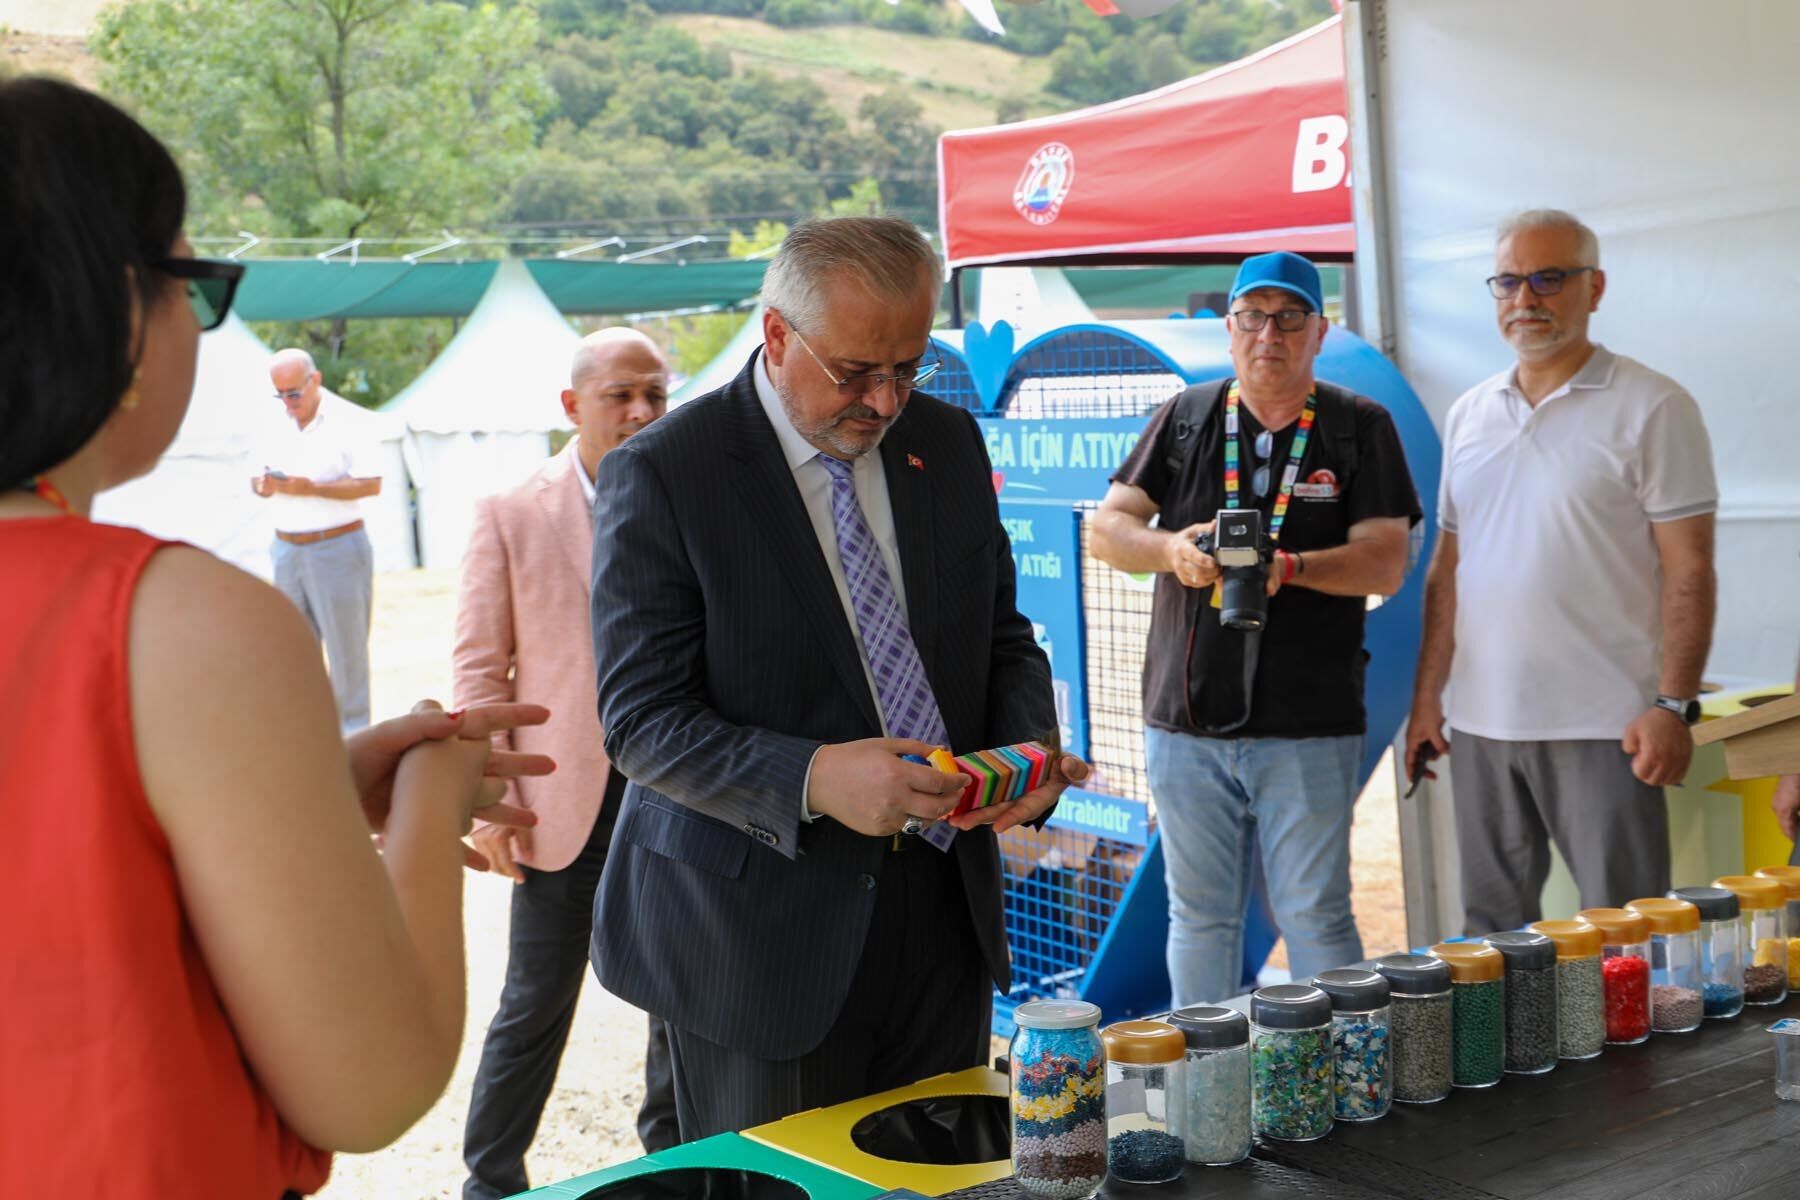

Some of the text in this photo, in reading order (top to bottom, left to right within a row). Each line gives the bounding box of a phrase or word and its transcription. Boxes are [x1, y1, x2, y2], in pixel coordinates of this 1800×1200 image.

[1292, 114, 1352, 193] B
[1020, 425, 1064, 475] İÇİN
[1021, 551, 1062, 579] ATIĞI
